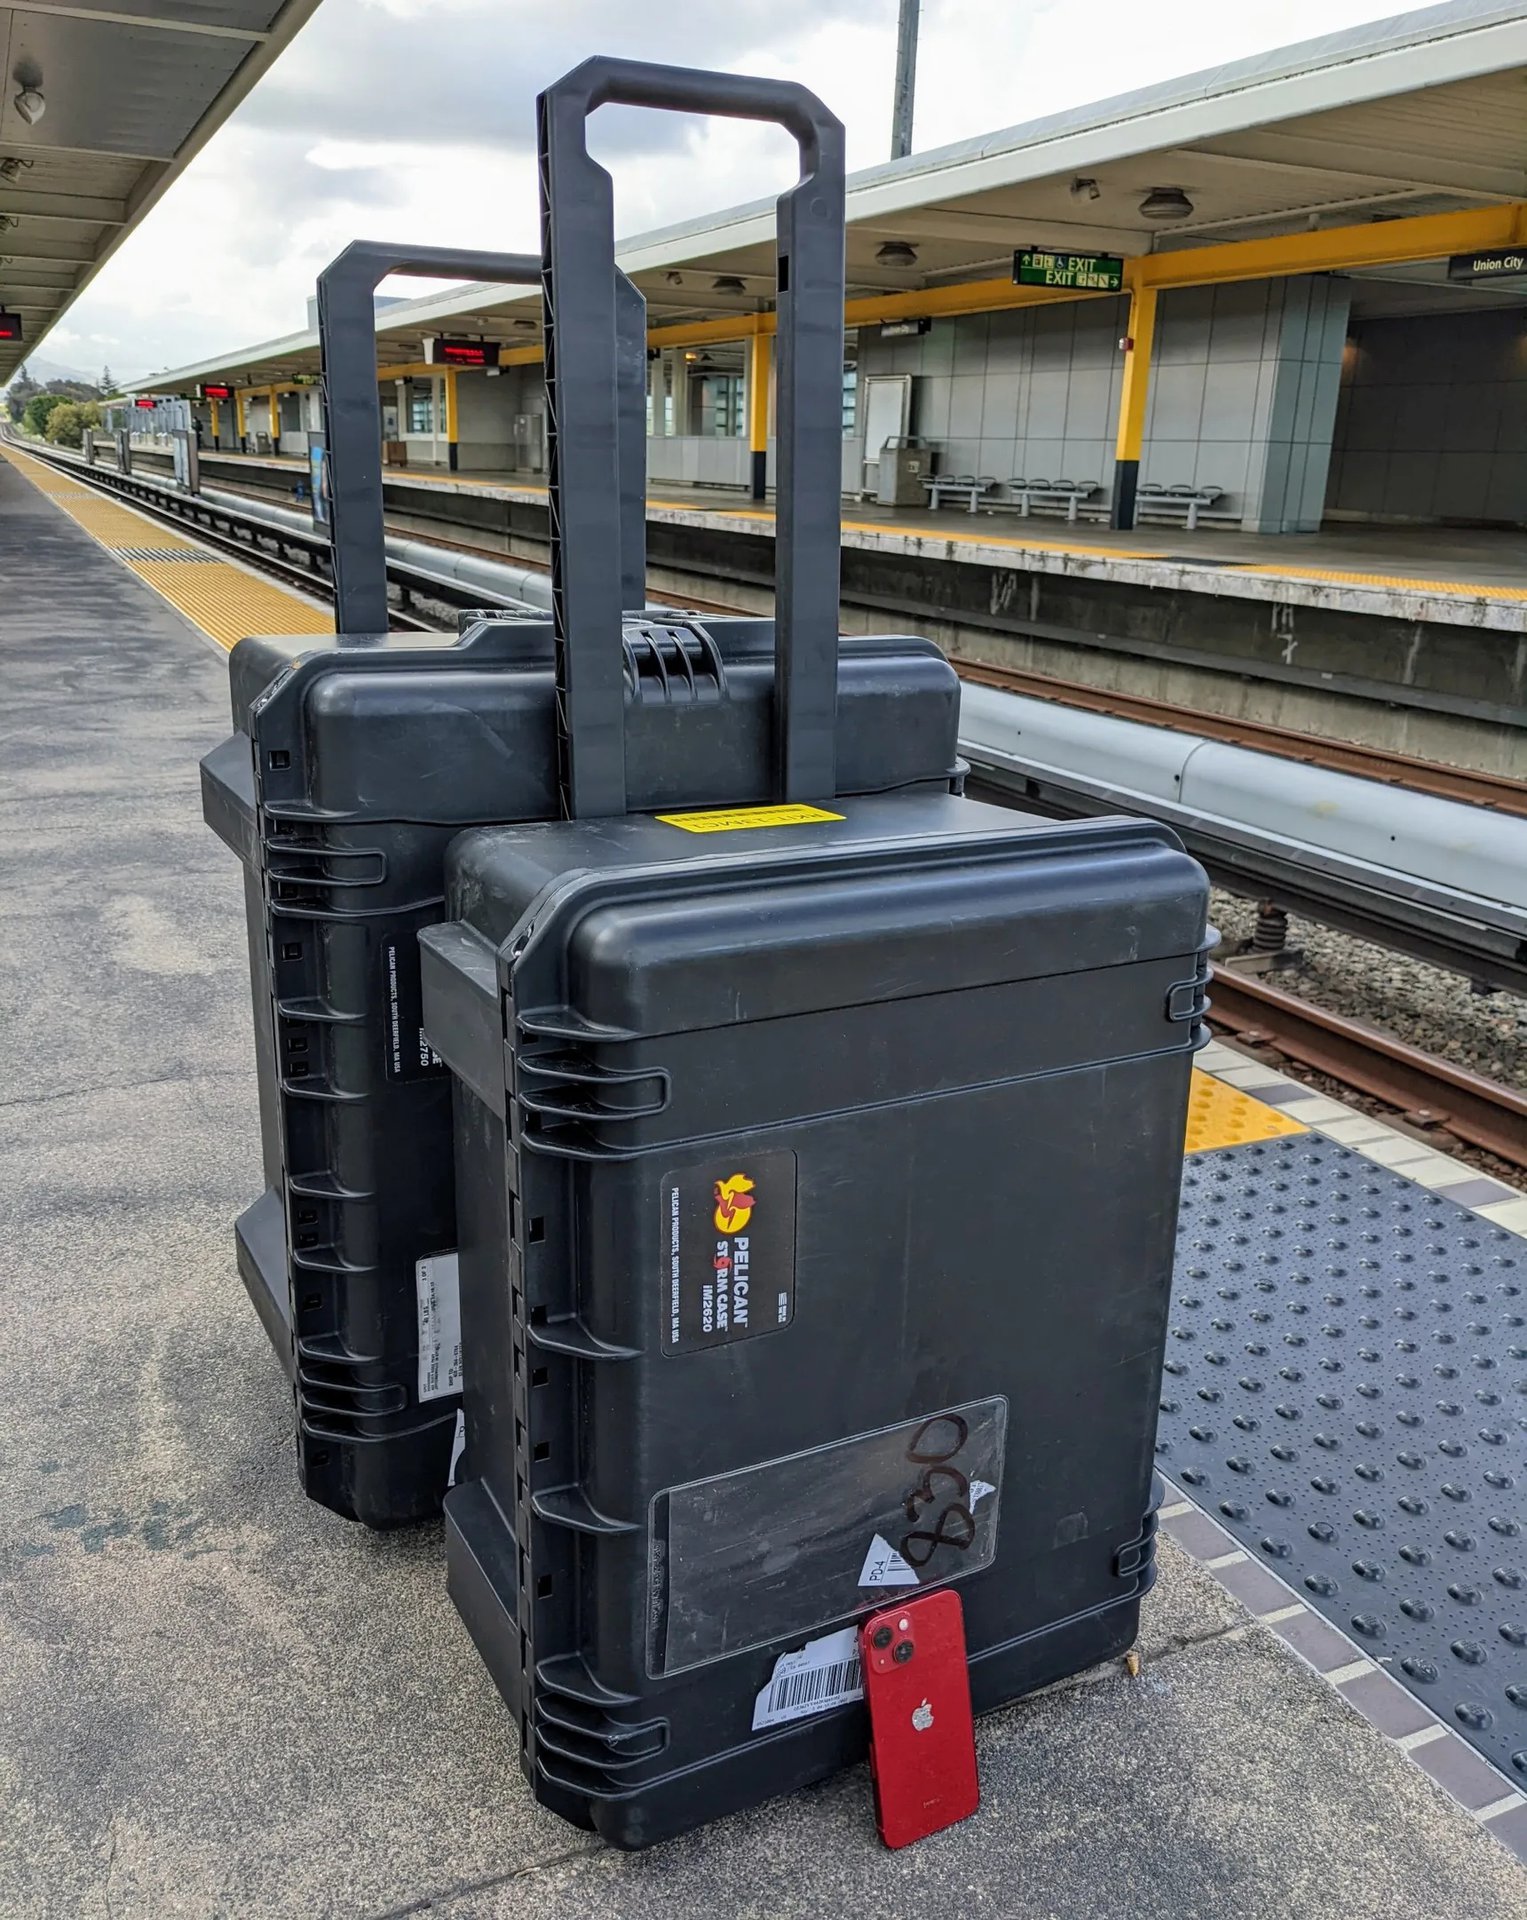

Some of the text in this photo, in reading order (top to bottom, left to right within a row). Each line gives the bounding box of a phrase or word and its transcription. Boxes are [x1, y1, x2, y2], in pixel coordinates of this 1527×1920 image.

[1068, 257, 1097, 272] EXIT
[1473, 256, 1525, 272] Union City
[1045, 270, 1074, 285] EXIT
[671, 1187, 680, 1344] PELICAN PRODUCTS, SOUTH DEERFIELD, MA USA
[714, 1240, 732, 1294] STORM
[901, 1413, 976, 1568] 830
[868, 1560, 886, 1581] PD-4
